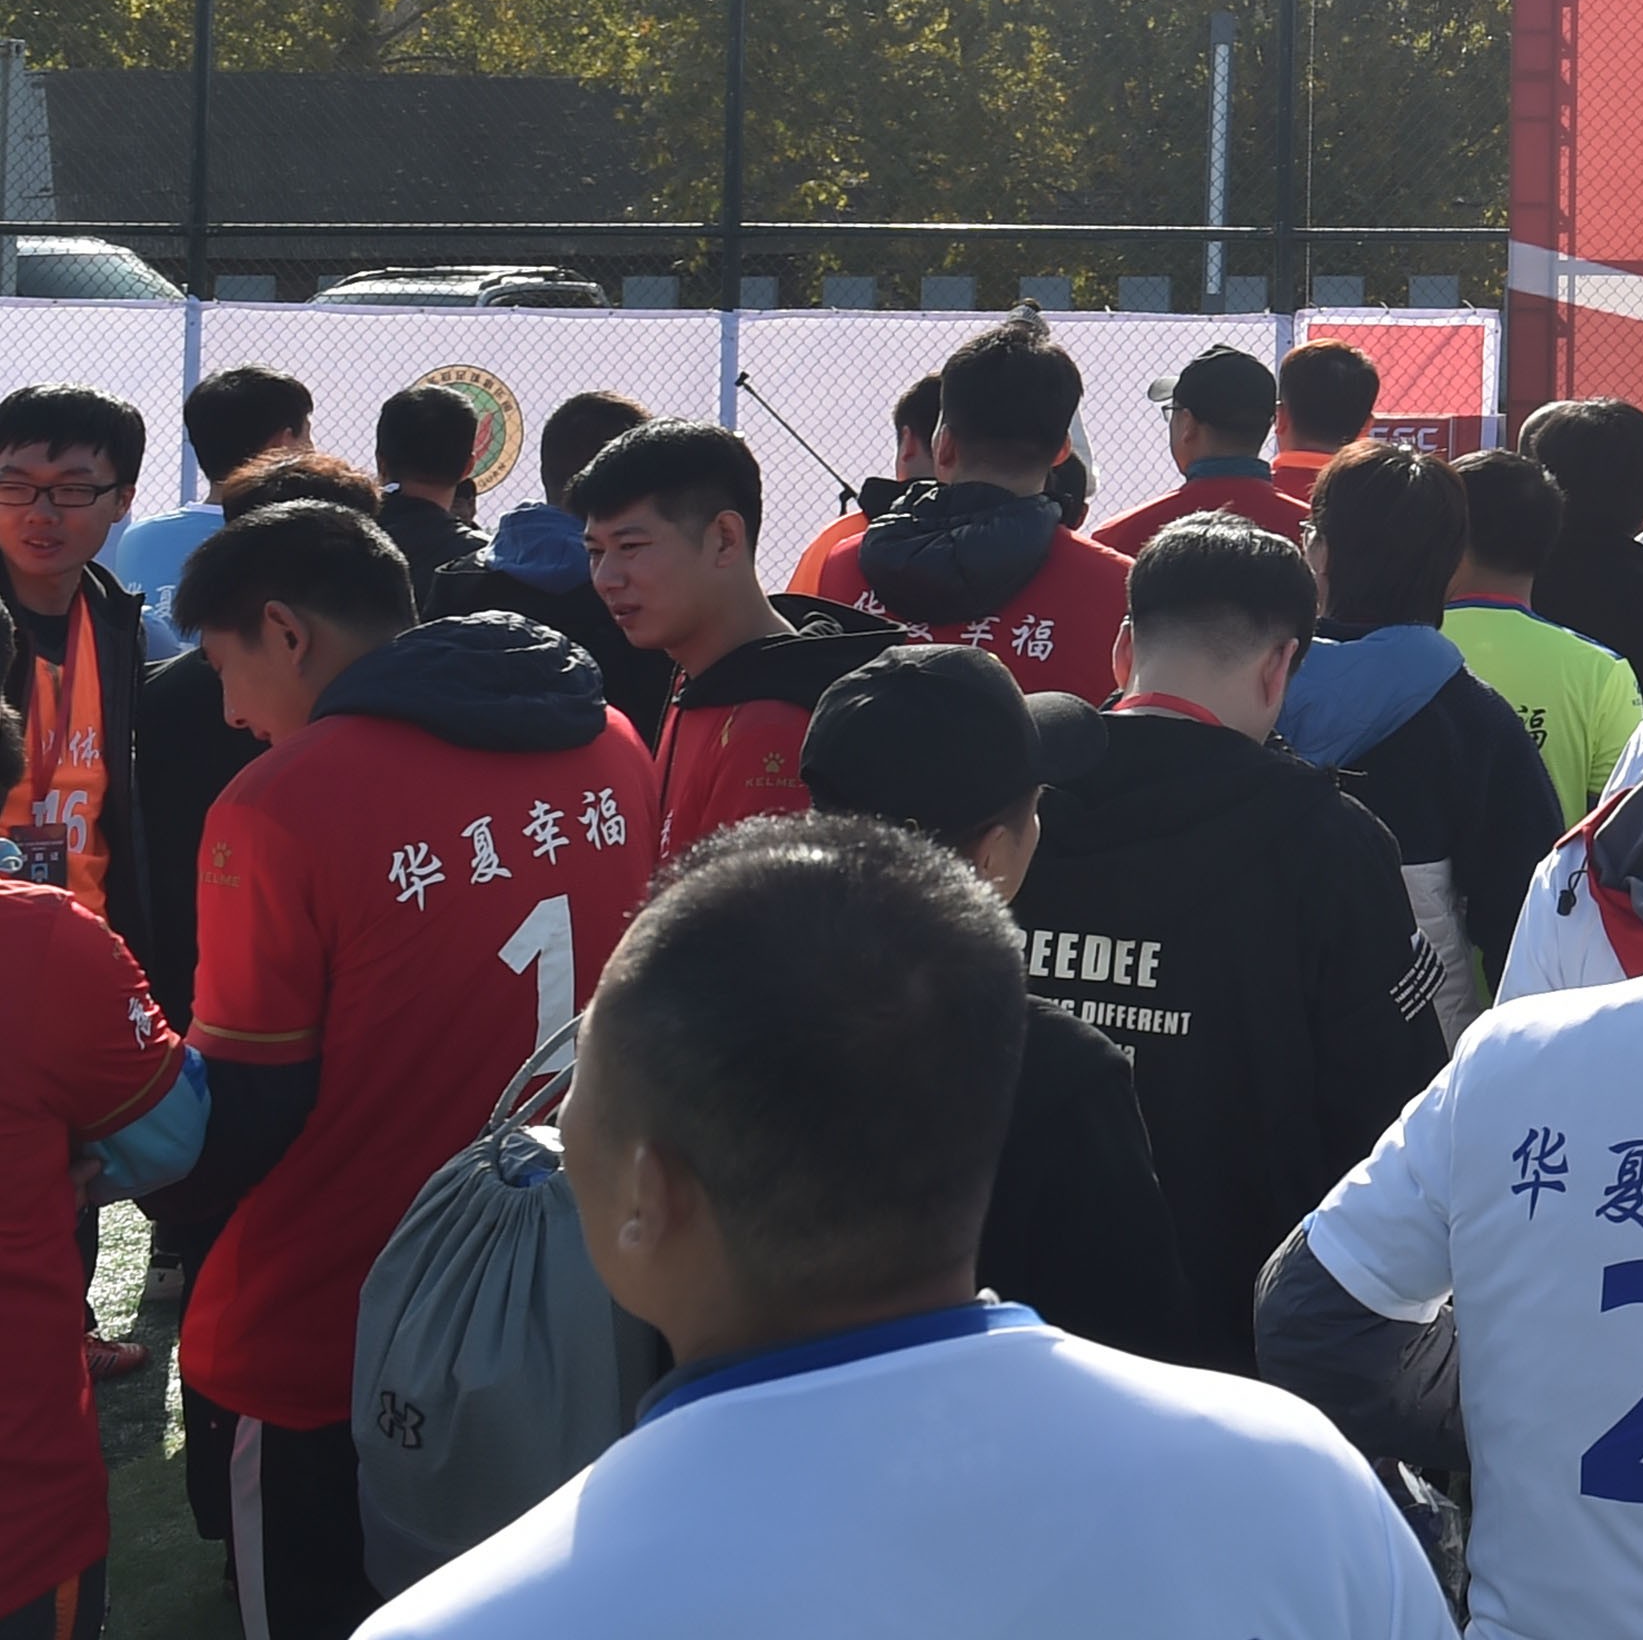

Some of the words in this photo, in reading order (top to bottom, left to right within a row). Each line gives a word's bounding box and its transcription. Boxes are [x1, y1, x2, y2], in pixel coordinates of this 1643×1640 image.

[387, 786, 628, 913] 华夏幸福
[497, 893, 576, 1077] 1
[1080, 999, 1192, 1036] DIFFERENT
